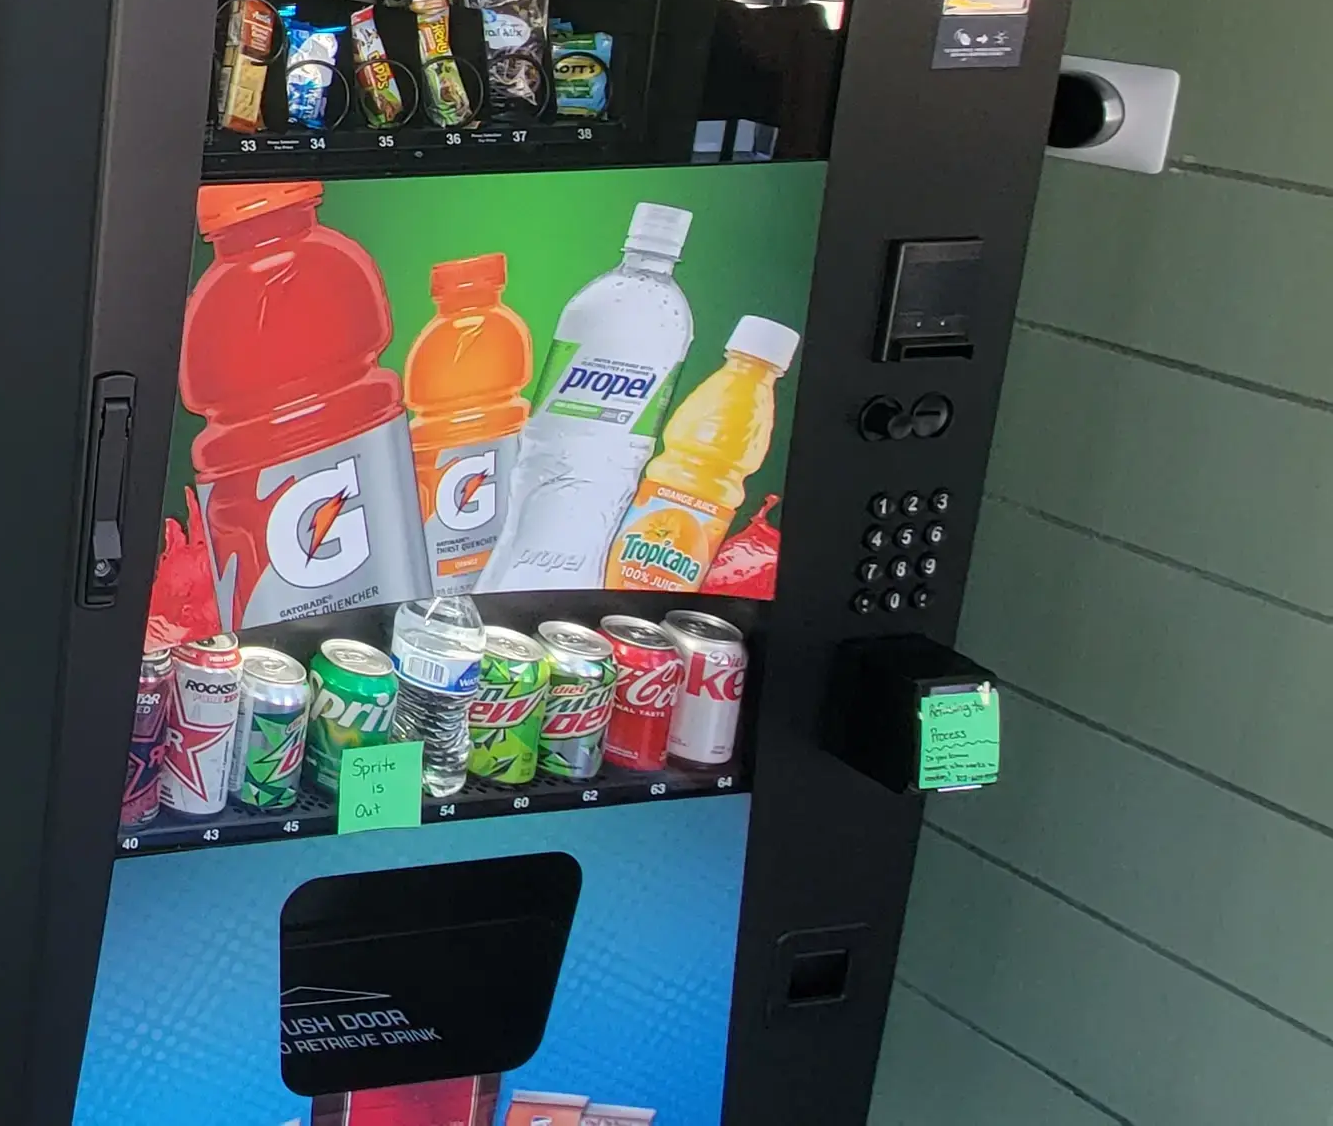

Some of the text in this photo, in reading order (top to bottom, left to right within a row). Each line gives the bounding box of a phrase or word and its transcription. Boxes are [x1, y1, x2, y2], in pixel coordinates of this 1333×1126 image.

[379, 136, 394, 147] 35
[446, 134, 461, 145] 36
[512, 131, 527, 142] 37
[578, 129, 592, 139] 38
[241, 140, 257, 151] 33
[310, 138, 325, 149] 34
[559, 367, 656, 400] propel
[435, 452, 497, 531] G
[657, 487, 719, 515] ORANGE JUICE
[878, 494, 948, 515] 1 2 3
[266, 458, 370, 587] G
[871, 526, 942, 548] 4 5 6
[437, 544, 459, 554] THIRST
[513, 550, 585, 573] propel
[621, 534, 700, 582] Tropicana
[621, 566, 650, 583] 100%
[866, 559, 936, 579] 7 8 9
[322, 585, 379, 613] QUENCHER
[890, 593, 900, 608] 0
[279, 596, 329, 618] GATORADE
[973, 701, 985, 712] to
[930, 728, 967, 743] Process
[353, 758, 396, 781] Sprite
[372, 784, 384, 794] is
[651, 784, 666, 794] 63
[718, 777, 732, 788] 64
[514, 797, 529, 808] 60
[583, 790, 598, 801] 62
[355, 804, 381, 819] Out
[440, 805, 455, 816] 54
[284, 822, 299, 832] 45
[204, 830, 219, 841] 43
[123, 838, 138, 850] 40
[281, 1009, 410, 1036] USH DOOR
[281, 1027, 442, 1054] O RETRIEVE DRINK
